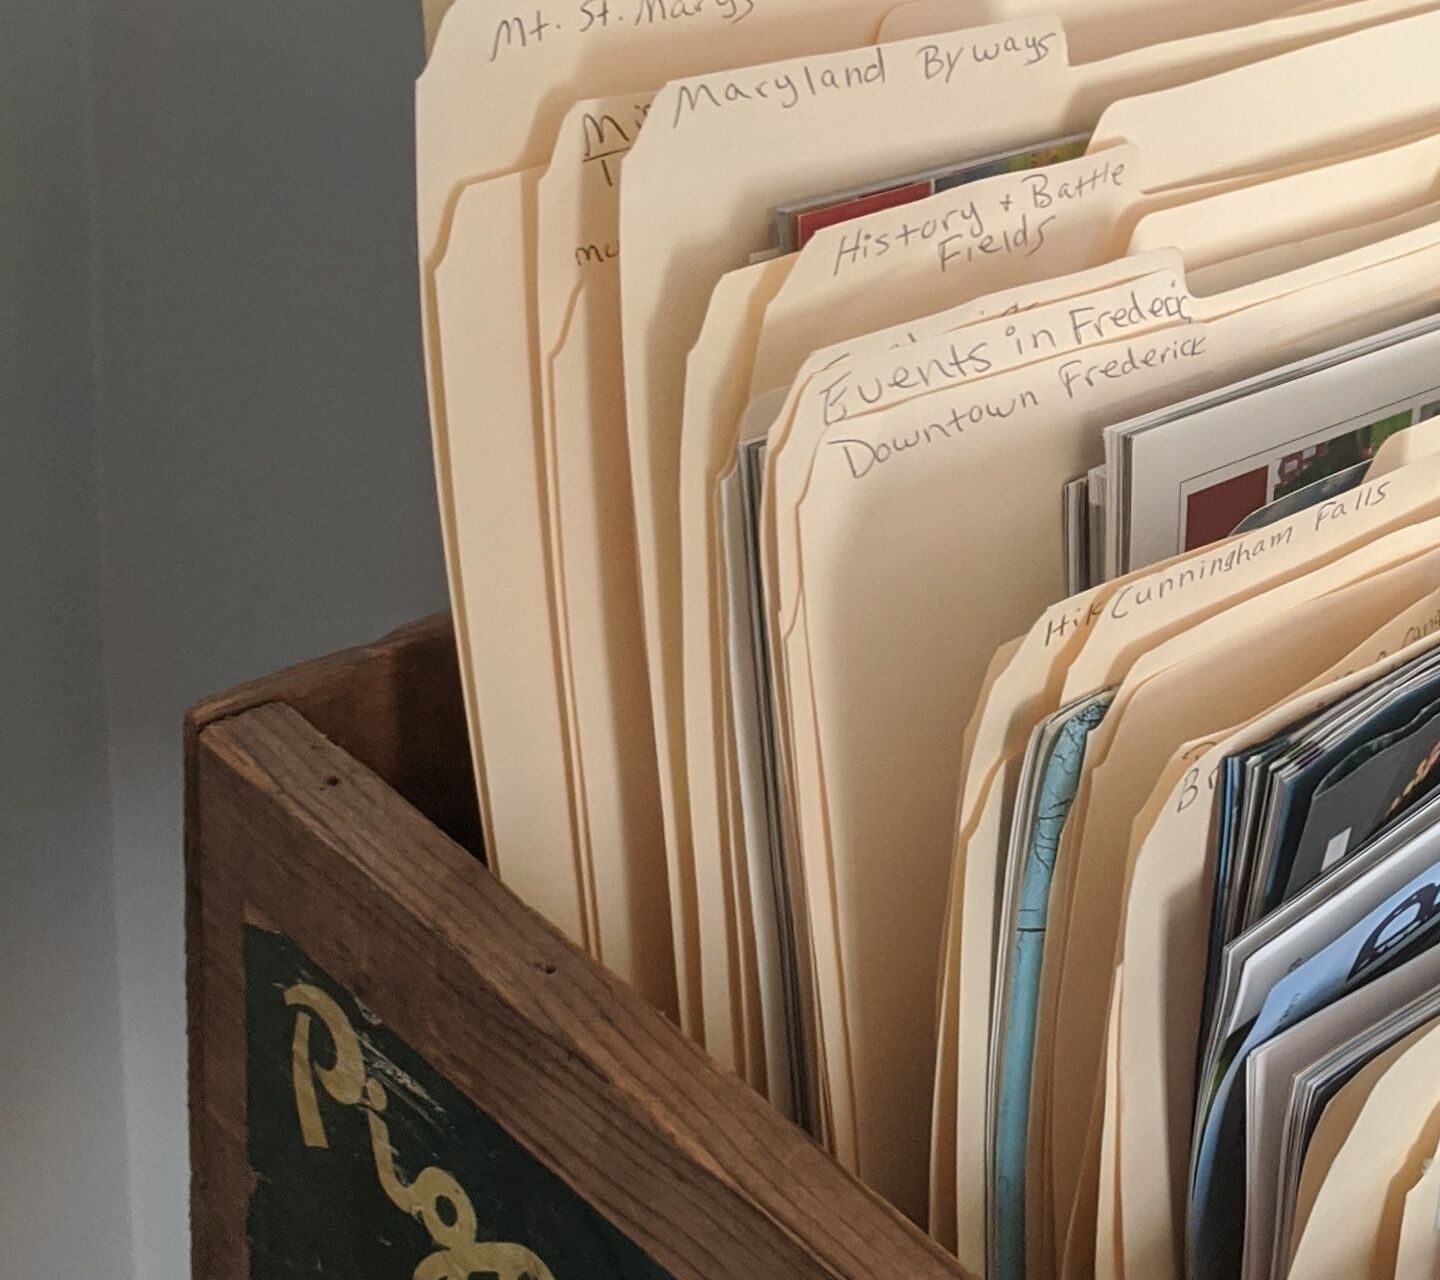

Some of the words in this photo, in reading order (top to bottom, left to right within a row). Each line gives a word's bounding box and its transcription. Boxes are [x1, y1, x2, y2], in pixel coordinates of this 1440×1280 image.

[490, 9, 562, 61] Mt.
[673, 47, 886, 128] Maryland
[834, 204, 980, 276] History
[1029, 161, 1126, 210] Battle
[937, 216, 1056, 273] Fields
[819, 342, 992, 426] Events
[1004, 326, 1056, 356] in
[828, 389, 1039, 480] Downtown
[1058, 336, 1207, 399] Frederick
[1111, 523, 1294, 620] Cunningham
[1315, 481, 1391, 532] Falls
